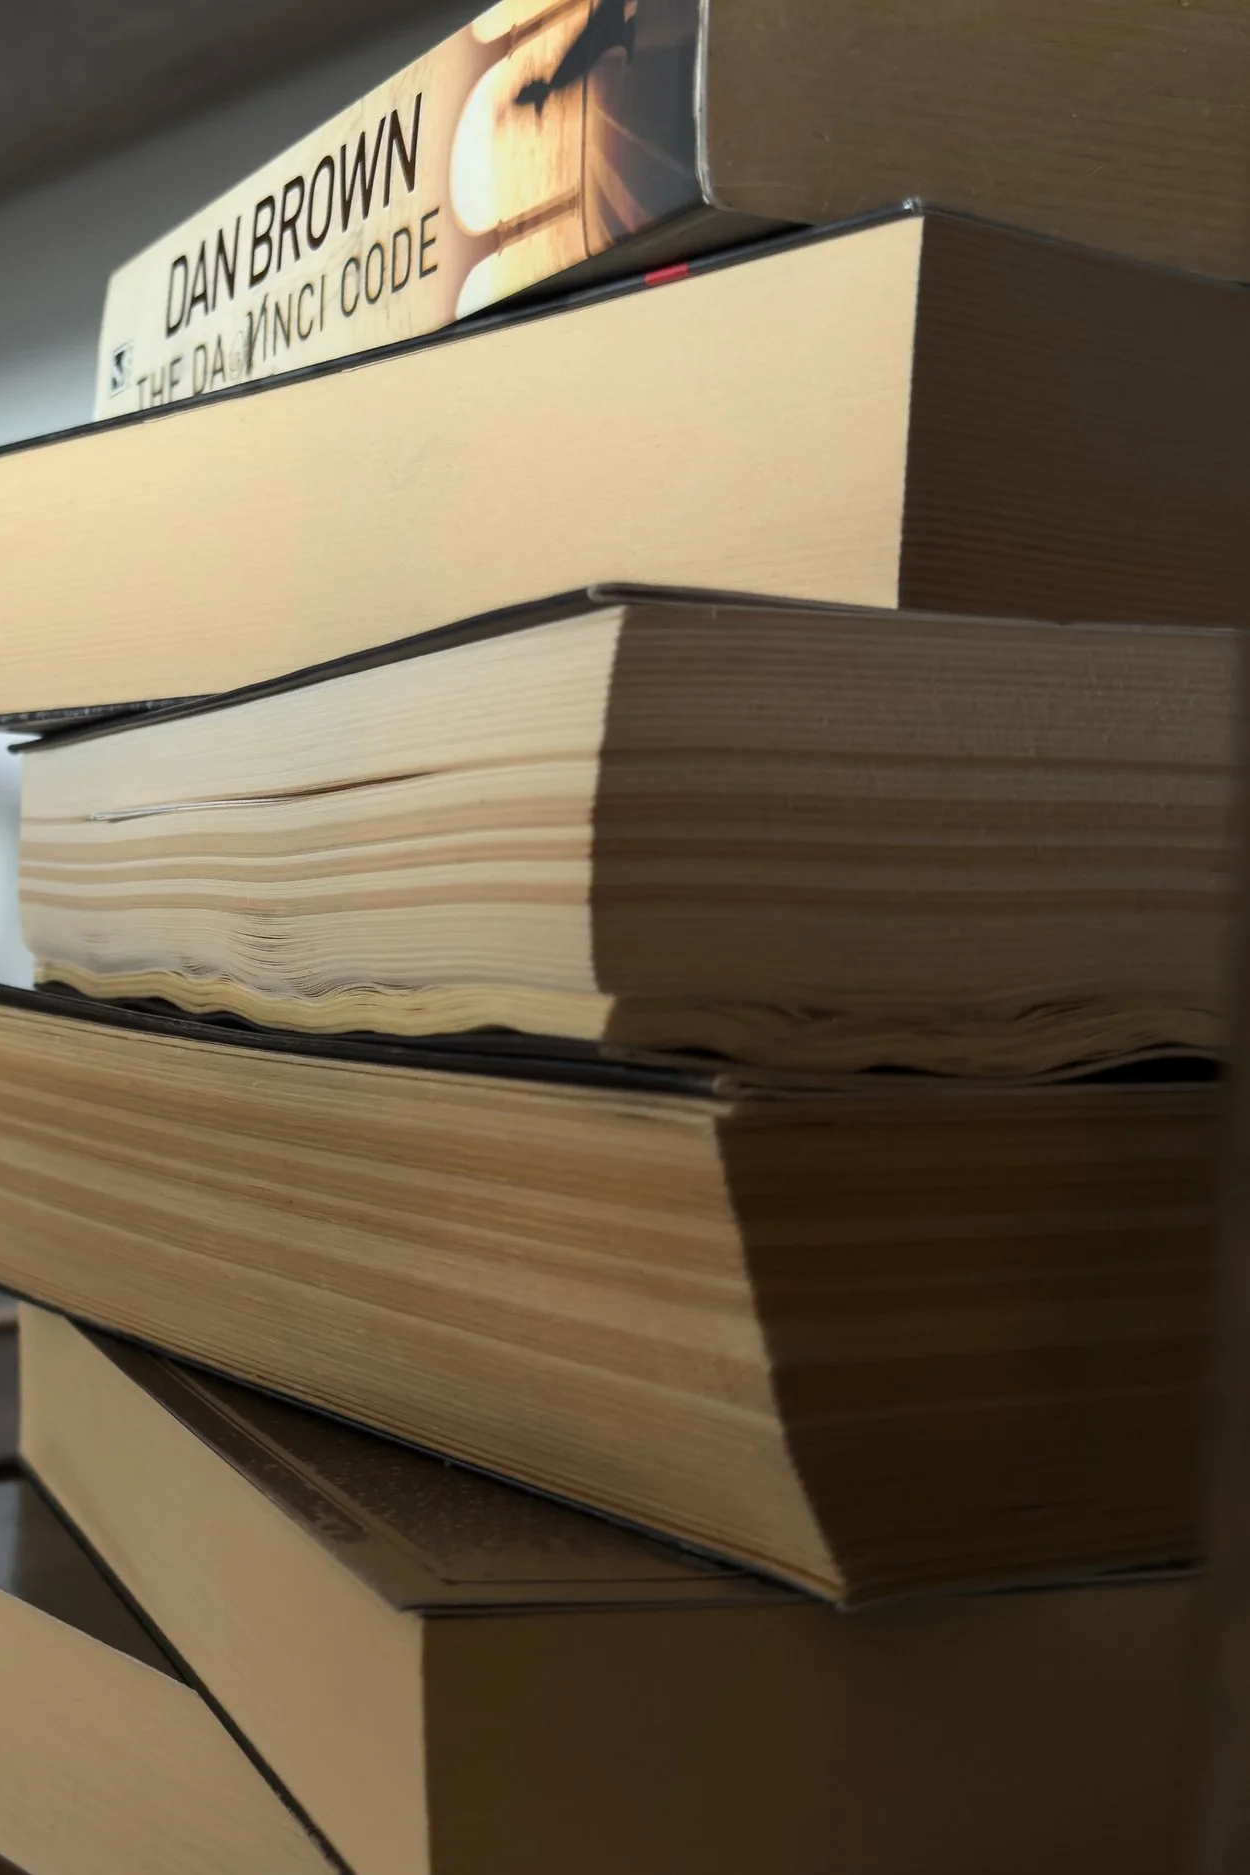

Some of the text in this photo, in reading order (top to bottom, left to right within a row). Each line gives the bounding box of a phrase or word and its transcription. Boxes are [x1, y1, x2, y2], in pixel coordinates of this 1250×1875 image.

[164, 92, 423, 339] DAN BROWN
[192, 334, 227, 396] DA
[246, 273, 327, 378] VINCI
[340, 207, 441, 318] CODE
